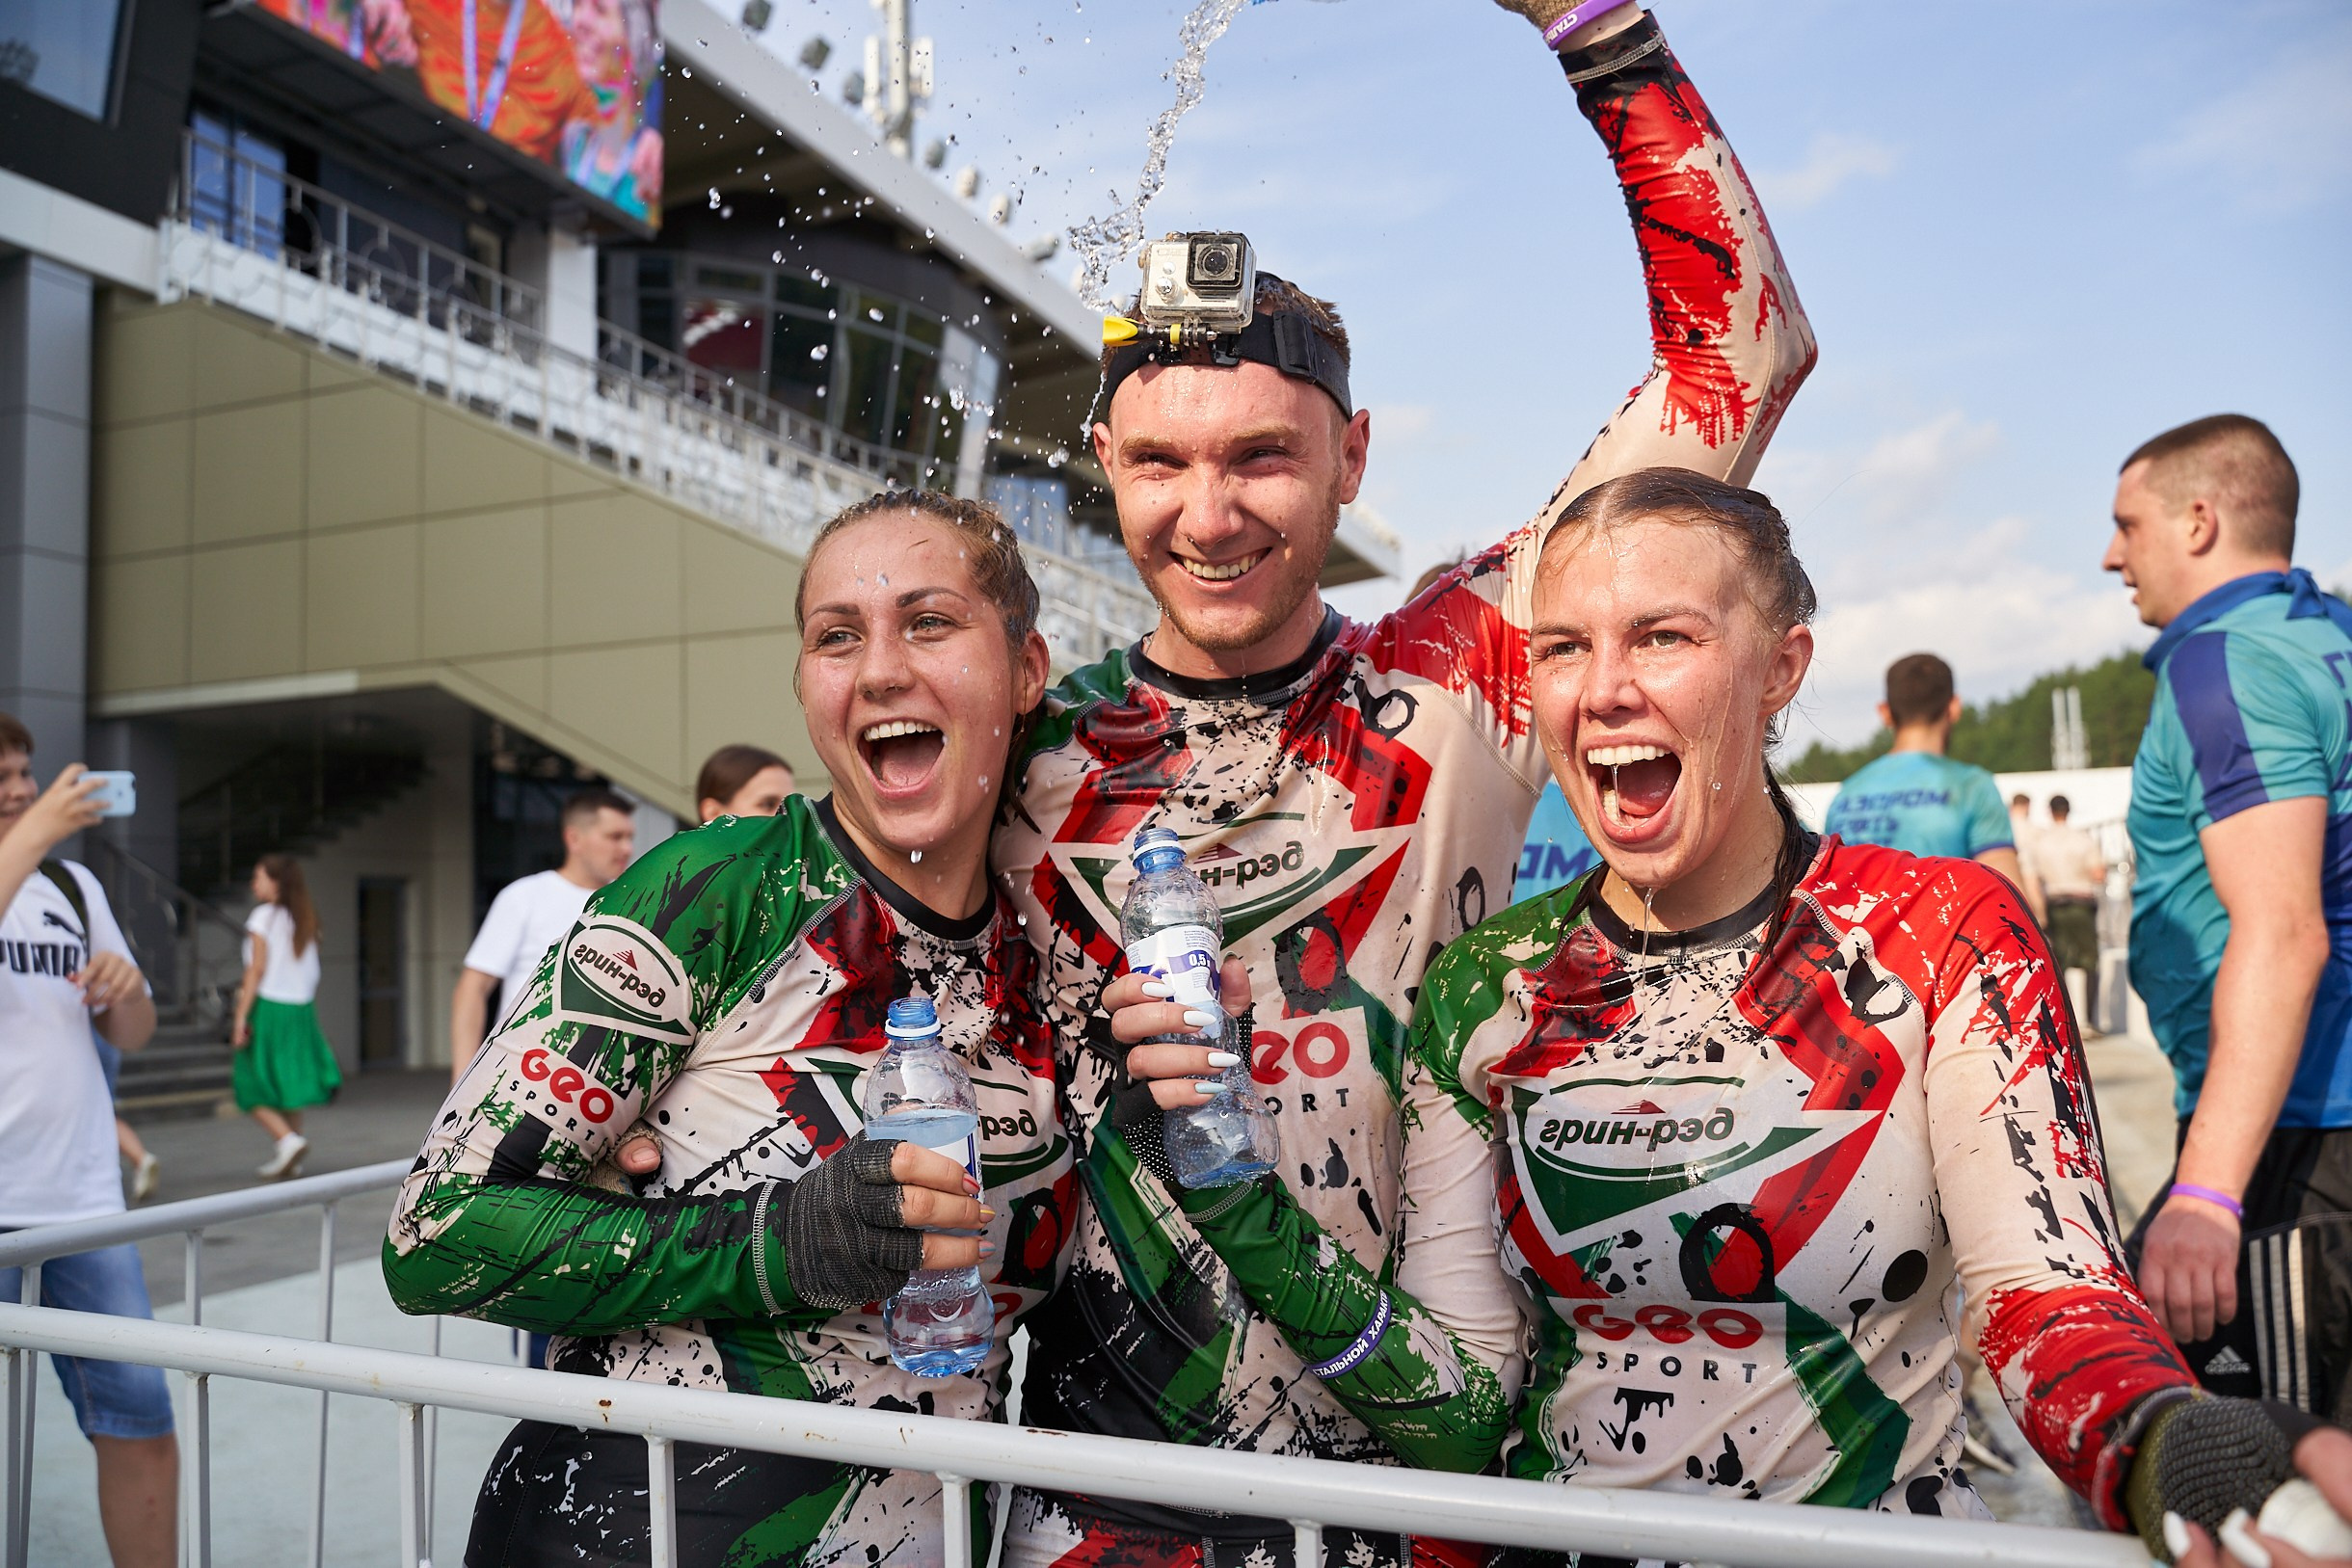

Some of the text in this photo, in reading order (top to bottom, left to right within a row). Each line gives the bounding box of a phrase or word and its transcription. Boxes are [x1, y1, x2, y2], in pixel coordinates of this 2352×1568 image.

[0, 940, 80, 976] UMA
[509, 1080, 595, 1141] SPORT
[1264, 1088, 1350, 1116] ORT
[977, 1108, 1038, 1141] рэд
[1312, 1337, 1369, 1376] СТАЛЬНОЙ
[1596, 1352, 1757, 1384] SPORT
